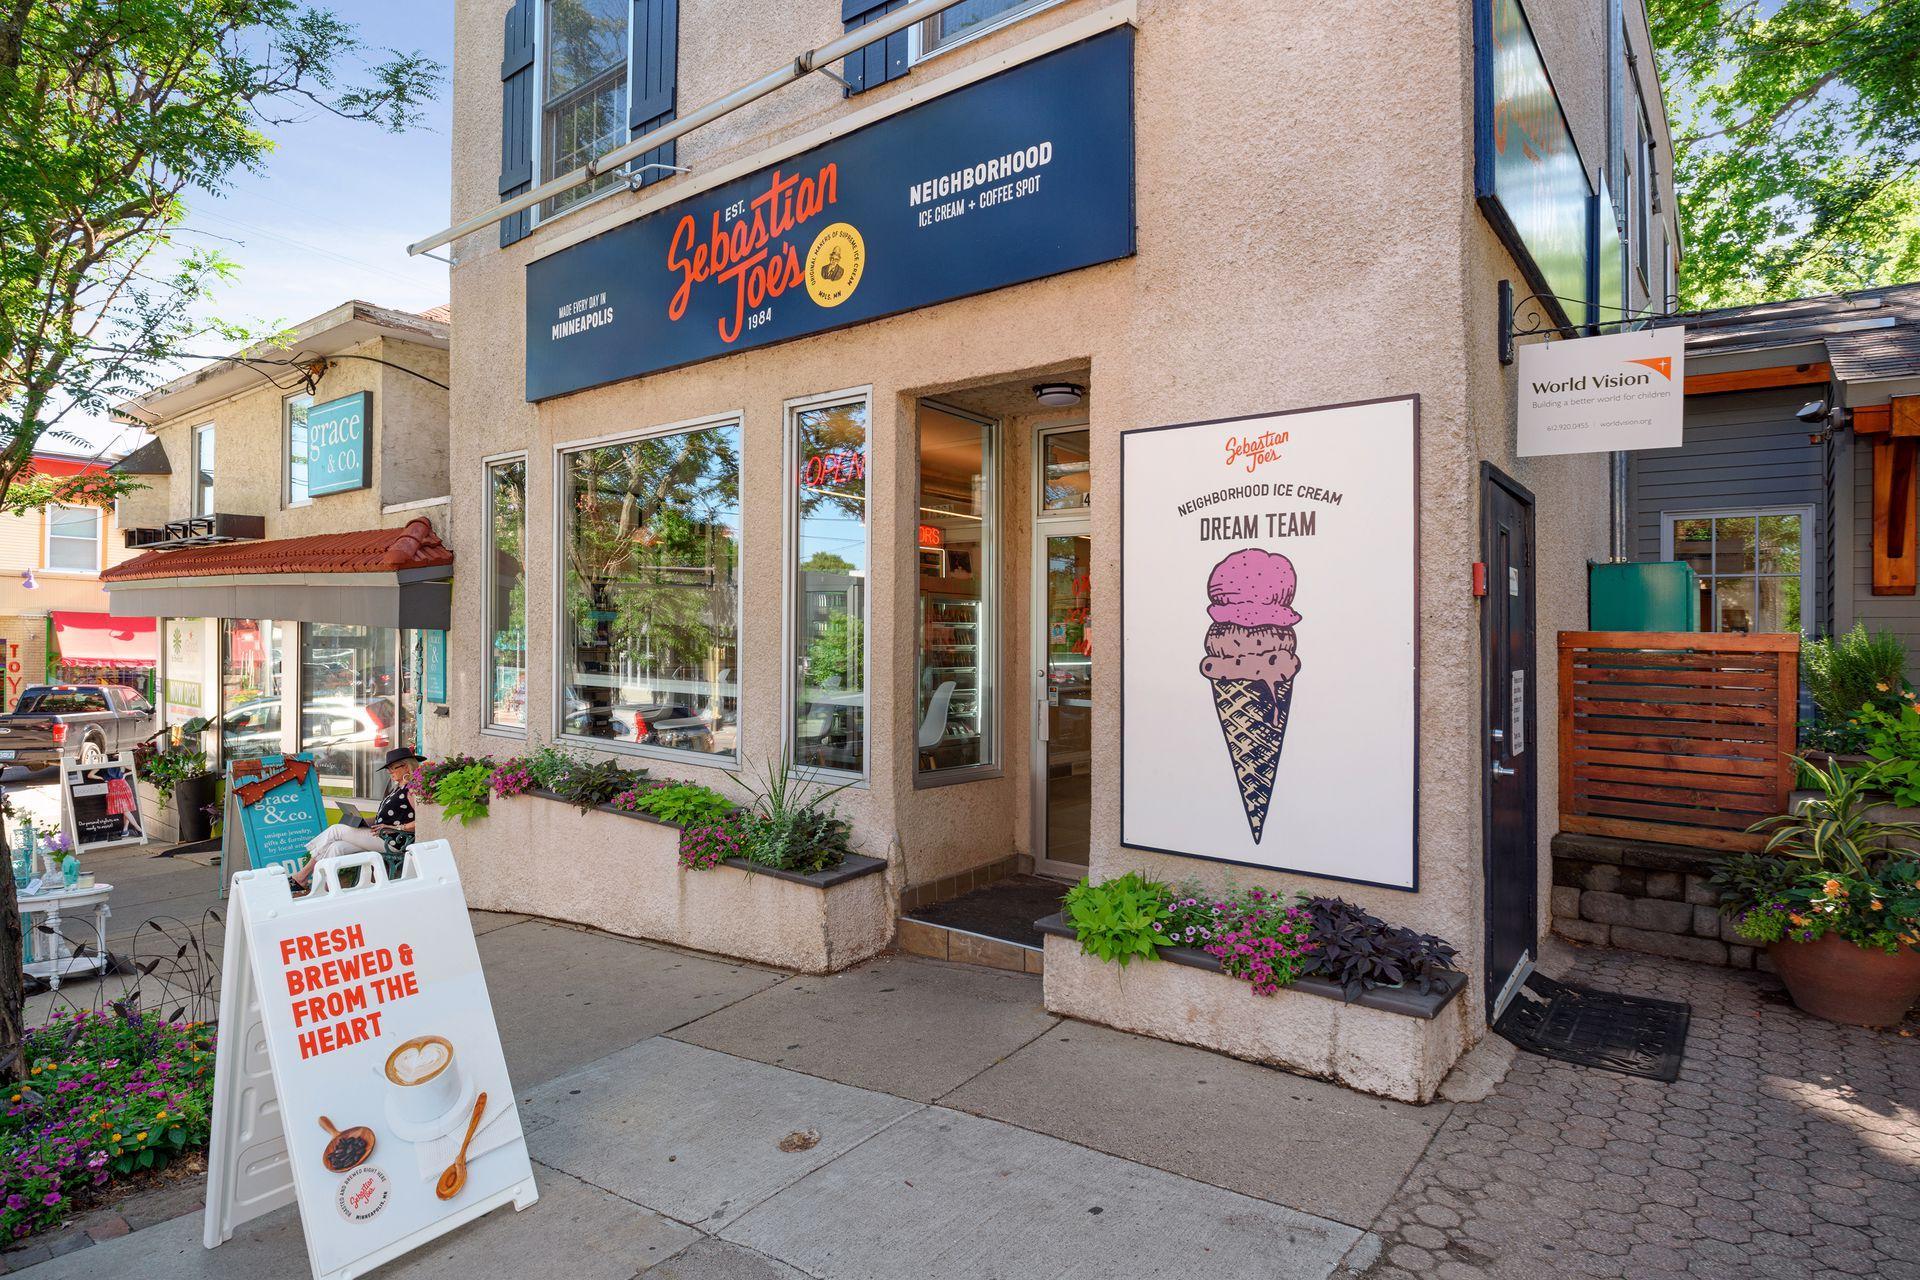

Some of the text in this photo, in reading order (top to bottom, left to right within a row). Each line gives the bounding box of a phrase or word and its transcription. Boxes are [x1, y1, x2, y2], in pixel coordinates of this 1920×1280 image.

[909, 141, 1053, 207] NEIGHBORHOOD
[725, 200, 745, 222] EST.
[919, 175, 1041, 227] ICE CREAM + COFFEE SPOT
[667, 162, 837, 321] Sebastian
[814, 234, 831, 256] MAKERS
[839, 230, 858, 250] SUPREME
[847, 263, 859, 286] CREAM
[559, 292, 606, 318] MADE EVERY DAY IN
[717, 242, 806, 343] Joe's
[552, 307, 613, 340] MINNEAPOLIS
[748, 307, 772, 330] 1984
[1532, 373, 1649, 394] World Vision
[1532, 400, 1561, 409] Building
[1570, 397, 1595, 405] better
[1597, 394, 1621, 403] world
[1623, 392, 1635, 400] for
[1637, 390, 1671, 399] children
[310, 415, 360, 462] grace
[1600, 418, 1652, 428] worldvision.org
[1225, 430, 1289, 465] Sebastian
[804, 452, 866, 486] OPEN
[1177, 484, 1343, 517] NEIGHBORHOOD ICE CREAM
[1200, 511, 1316, 541] DREAM TEAM
[279, 923, 365, 965] FRESH
[285, 943, 414, 997] BREWED &
[291, 970, 419, 1028] FROM THE
[298, 1011, 382, 1060] HEART
[344, 1168, 362, 1185] BREWED
[349, 1178, 374, 1209] Sebastian
